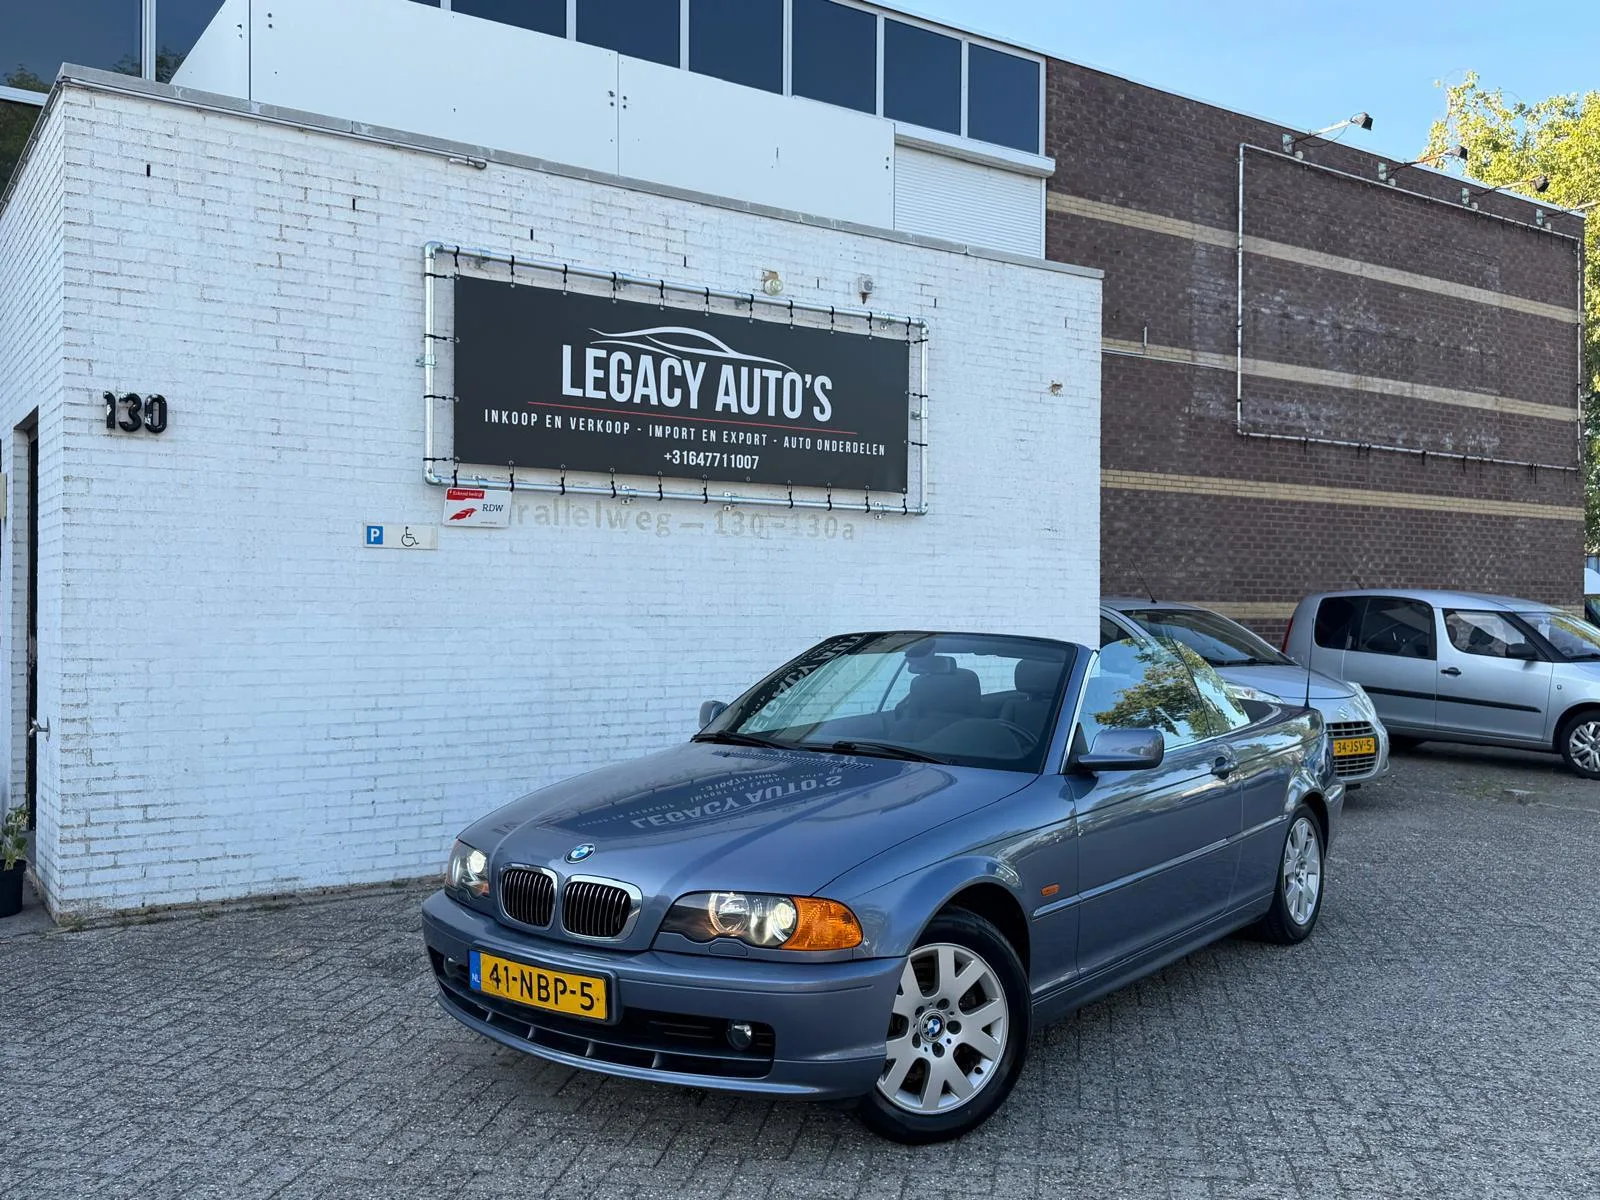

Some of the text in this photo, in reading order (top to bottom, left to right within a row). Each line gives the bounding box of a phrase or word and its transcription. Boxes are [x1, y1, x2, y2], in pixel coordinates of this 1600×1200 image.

[562, 344, 833, 422] LEGACY AUTO'S
[103, 391, 167, 433] 130
[484, 409, 538, 426] INKOOP
[545, 414, 562, 429] EN
[570, 417, 630, 435] VERKOOP
[649, 424, 696, 441] IMPORT
[702, 429, 716, 443] EN
[722, 430, 767, 447] EXPORT
[783, 436, 811, 450] AUTO
[816, 439, 885, 456] ONDERDELEN
[663, 450, 760, 470] +31647711007
[482, 503, 504, 512] RDW
[508, 499, 672, 538] rallelweg
[370, 528, 380, 543] P
[471, 973, 480, 983] NL
[489, 962, 595, 1012] 41-NBP-5
